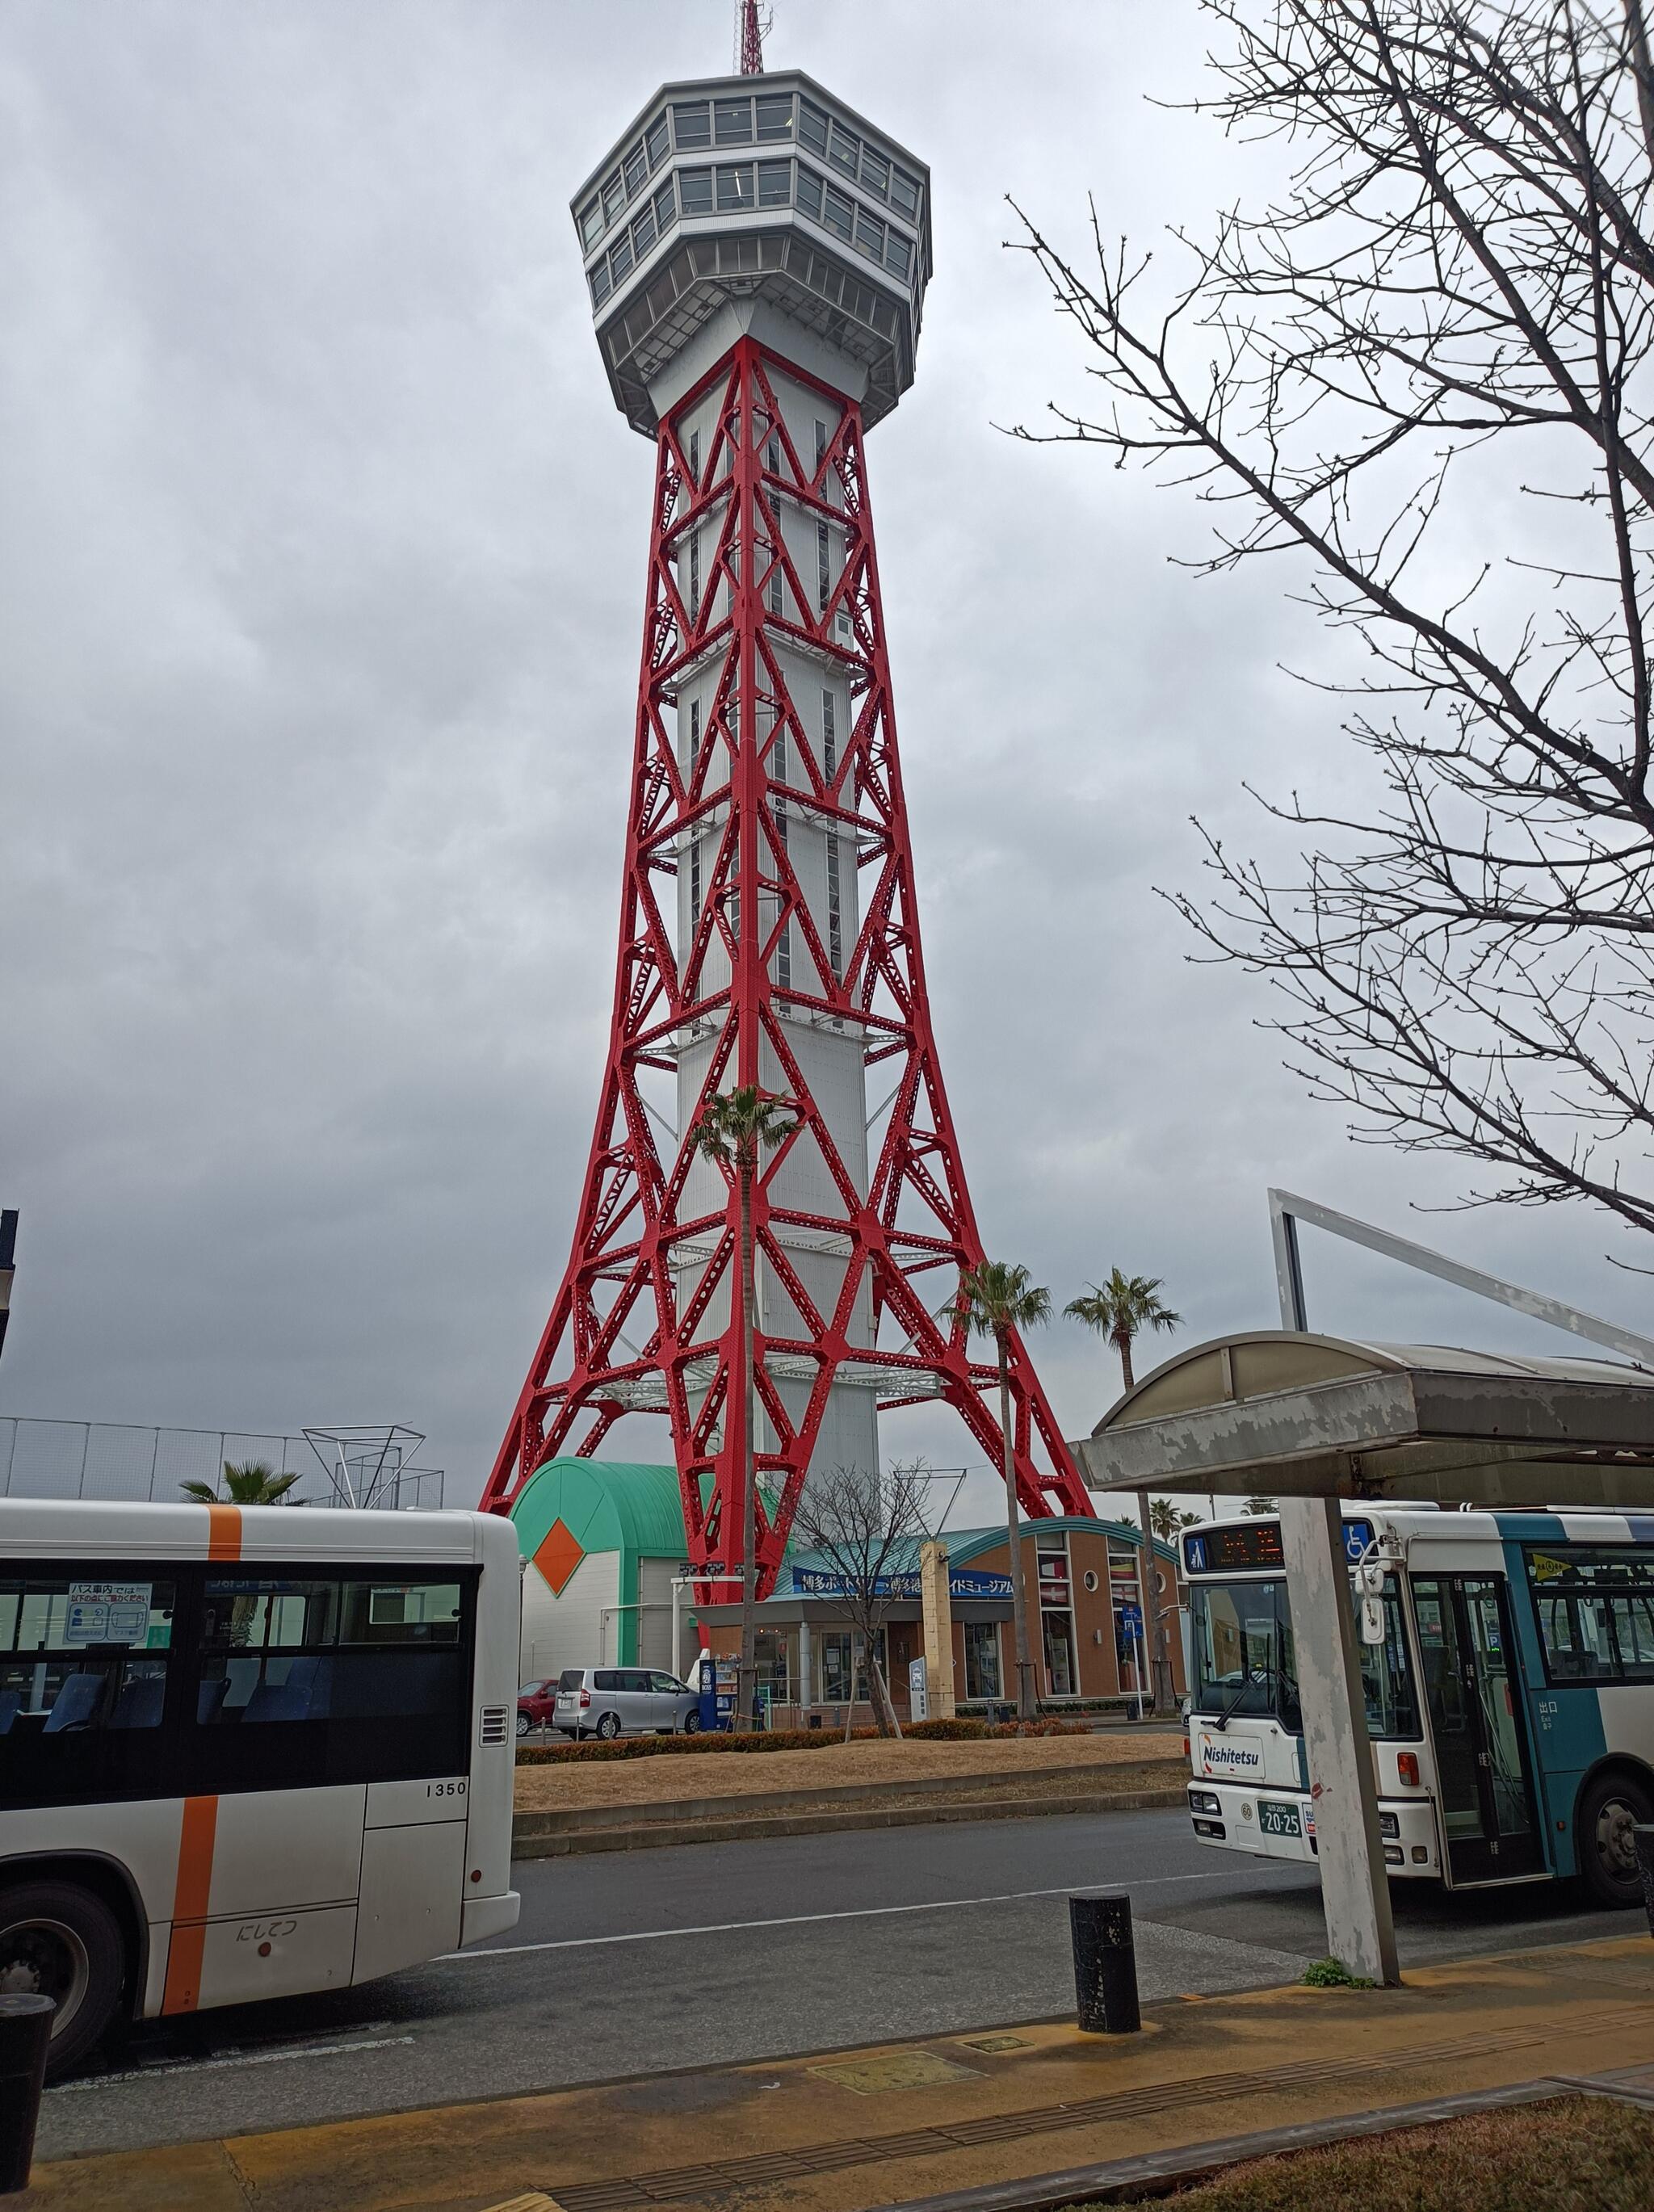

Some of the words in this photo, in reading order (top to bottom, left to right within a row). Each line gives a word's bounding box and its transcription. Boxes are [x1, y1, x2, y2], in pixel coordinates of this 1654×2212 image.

[71, 1584, 136, 1594] バス車内では
[1539, 1702, 1557, 1713] 出口
[1203, 1746, 1258, 1765] Nishitetsu
[427, 1782, 466, 1798] 1350
[1242, 1807, 1251, 1817] 60
[236, 1920, 297, 1941] にしてつ
